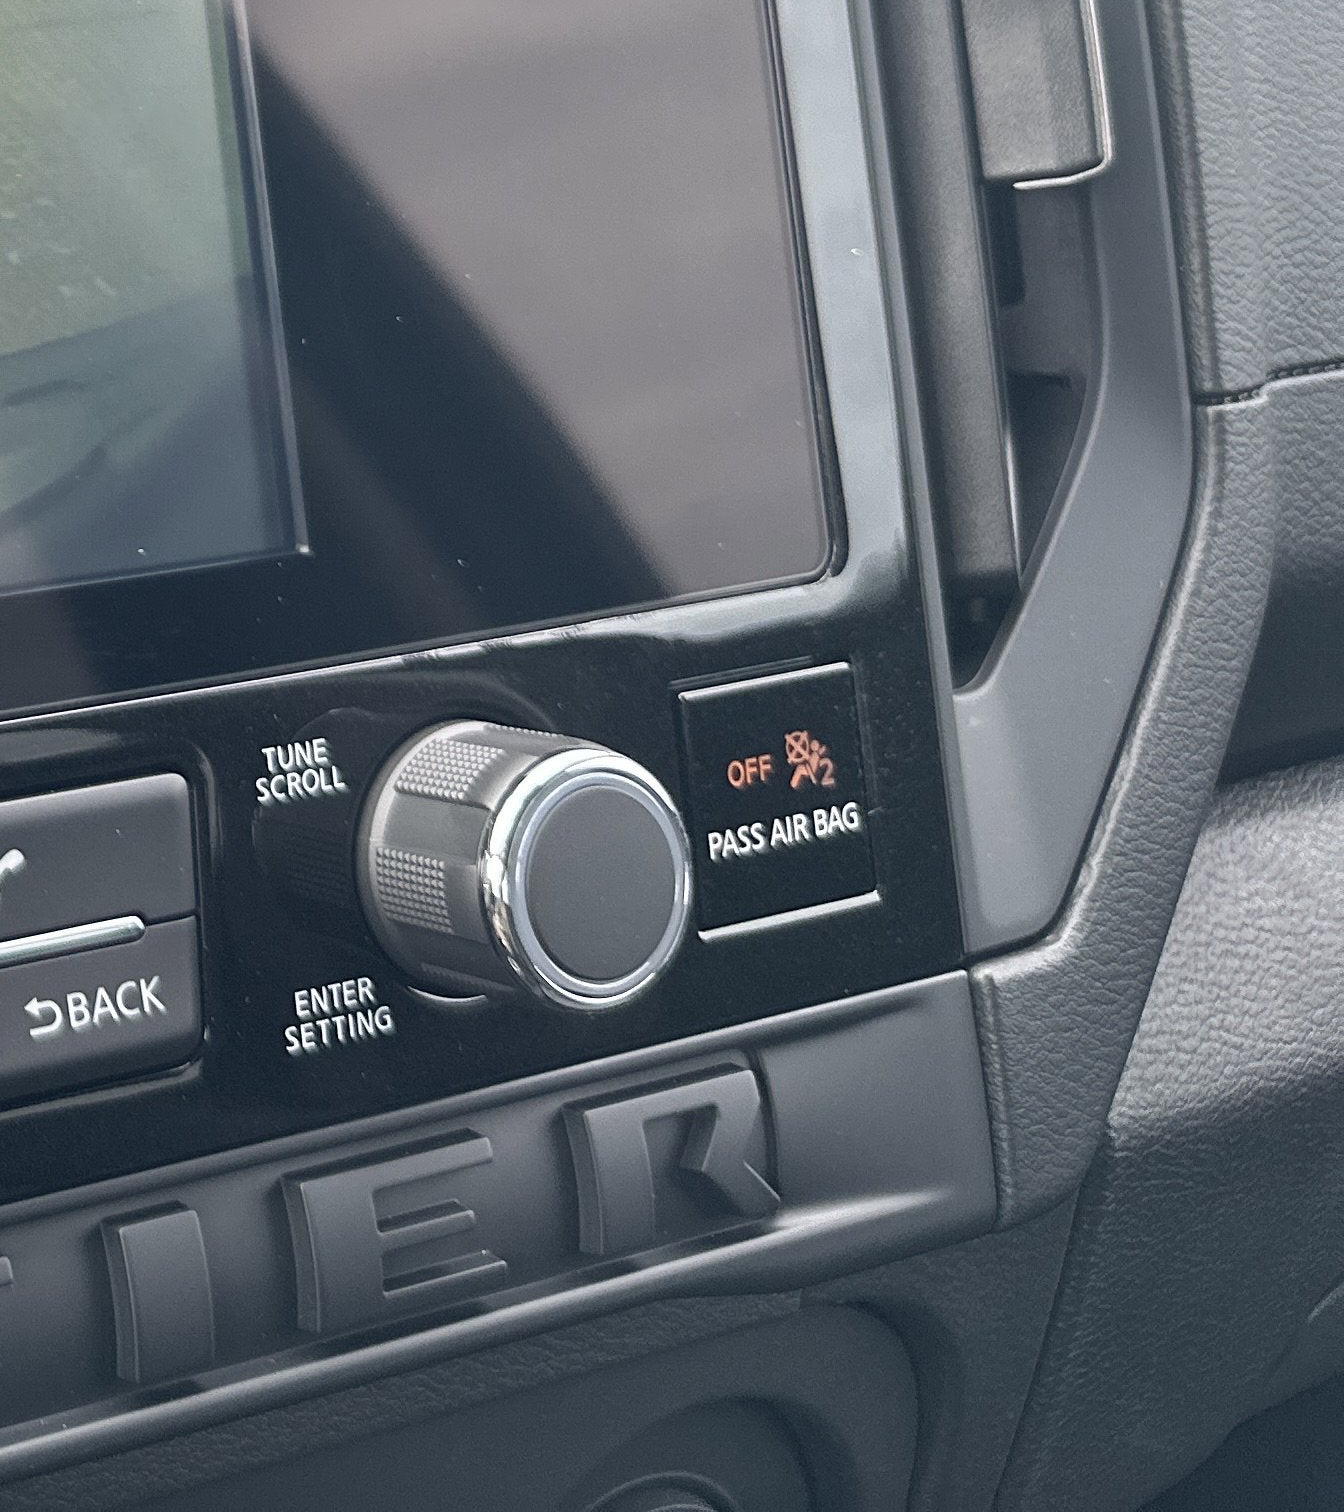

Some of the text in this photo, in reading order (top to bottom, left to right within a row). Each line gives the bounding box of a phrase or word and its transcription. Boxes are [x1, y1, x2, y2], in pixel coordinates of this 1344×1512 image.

[262, 737, 330, 772] TUNE
[727, 754, 773, 787] OFF
[255, 764, 346, 803] SCROLL
[708, 801, 862, 861] PASS AIR BAG
[66, 975, 167, 1031] BACK
[293, 976, 375, 1017] ENTER
[284, 1005, 394, 1055] SETTING
